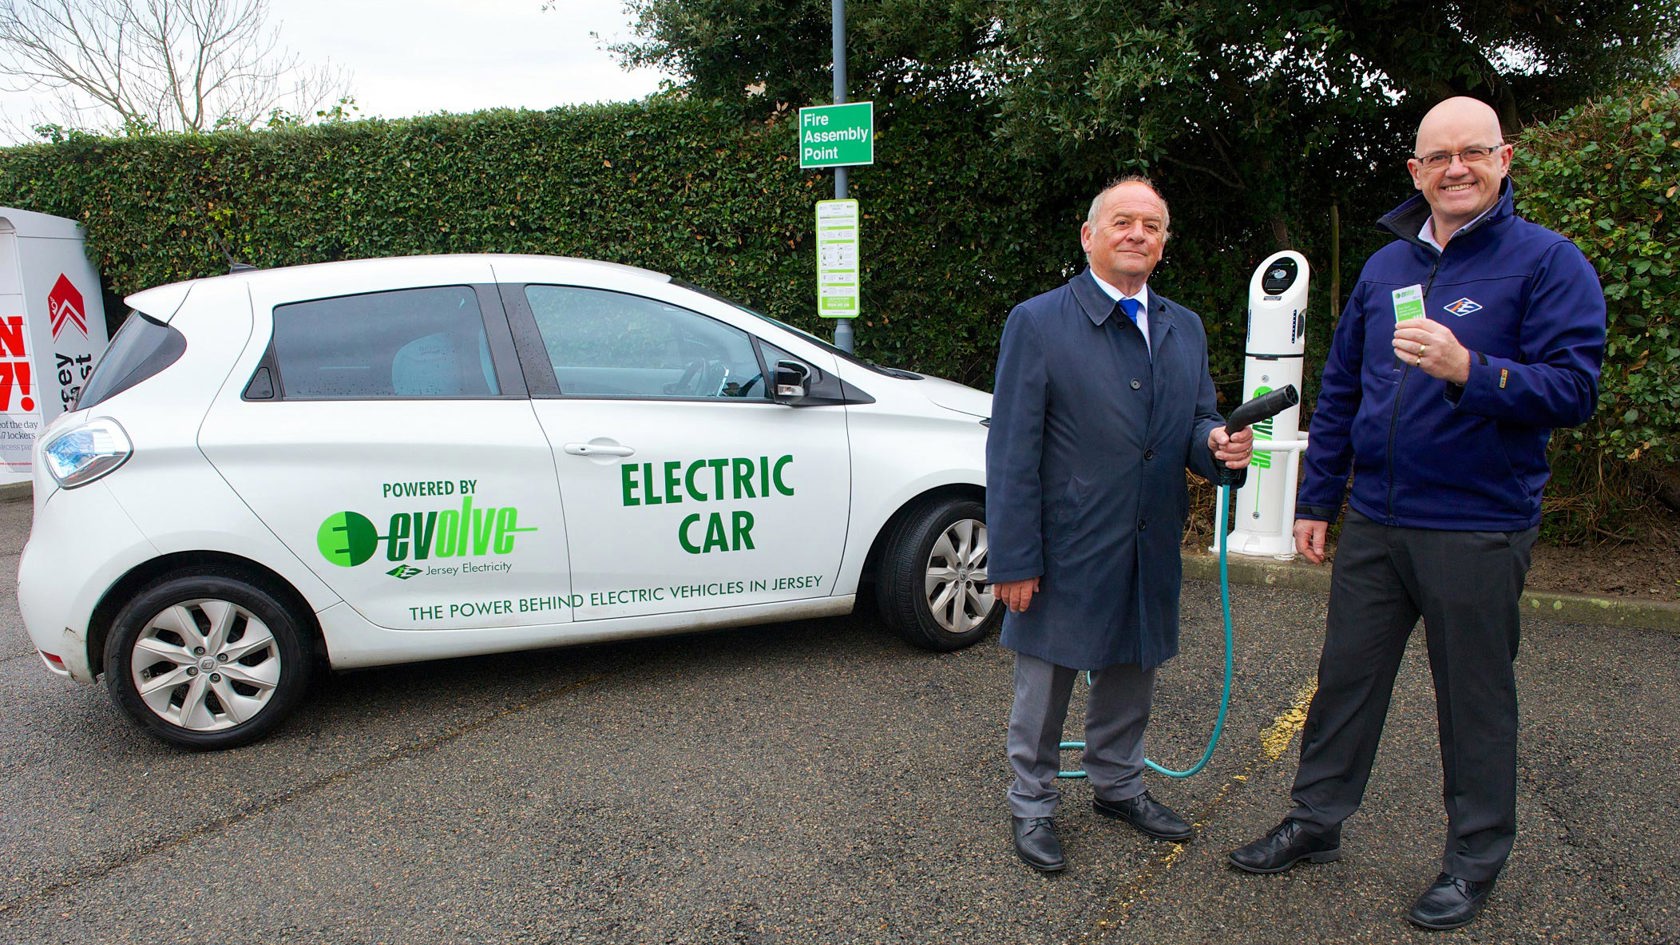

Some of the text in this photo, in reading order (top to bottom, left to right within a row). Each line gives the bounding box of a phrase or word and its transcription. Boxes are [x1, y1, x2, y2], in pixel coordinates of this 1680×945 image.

[804, 113, 829, 127] Fire
[804, 126, 868, 143] Assembly
[804, 146, 838, 161] Point
[10, 421, 22, 429] the
[24, 421, 38, 430] day
[7, 431, 36, 440] lockers
[383, 480, 477, 498] POWERED BY
[621, 454, 794, 507] ELECTRIC
[387, 496, 538, 561] evolve
[678, 510, 755, 554] CAR
[426, 561, 512, 577] Jersey Electricity
[409, 575, 823, 621] THE POWER BEHIND ELECTRIC VEHICLES IN JERSEY
